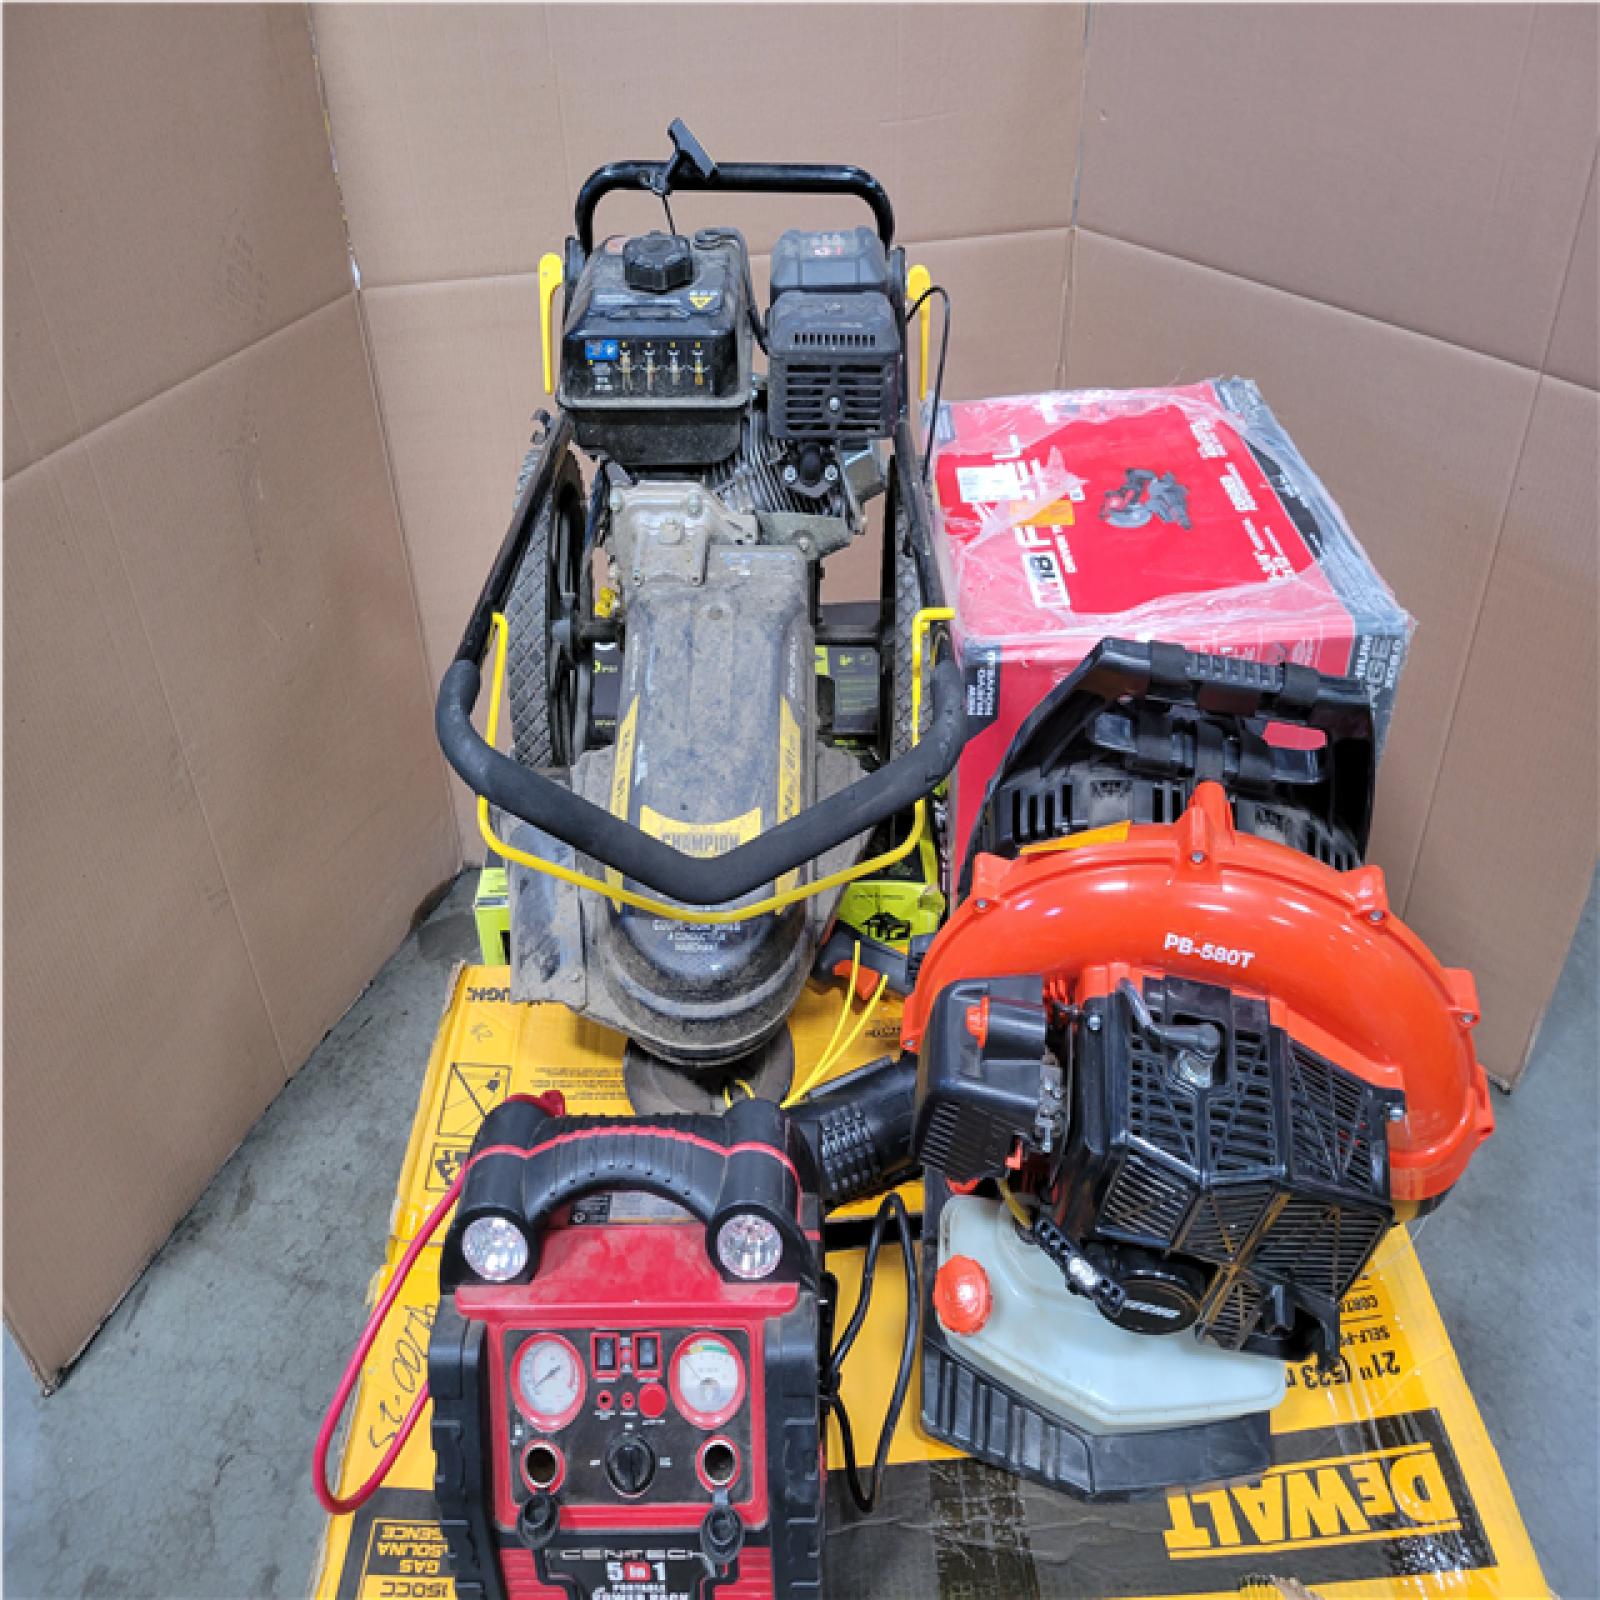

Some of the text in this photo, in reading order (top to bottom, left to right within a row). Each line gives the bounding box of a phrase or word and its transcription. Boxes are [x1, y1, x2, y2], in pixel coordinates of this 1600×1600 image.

[1163, 932, 1255, 968] PB-580T
[1163, 1453, 1456, 1550] DEWALT
[399, 1559, 441, 1574] GAS
[606, 1562, 624, 1581] 5
[652, 1562, 665, 1581] 1
